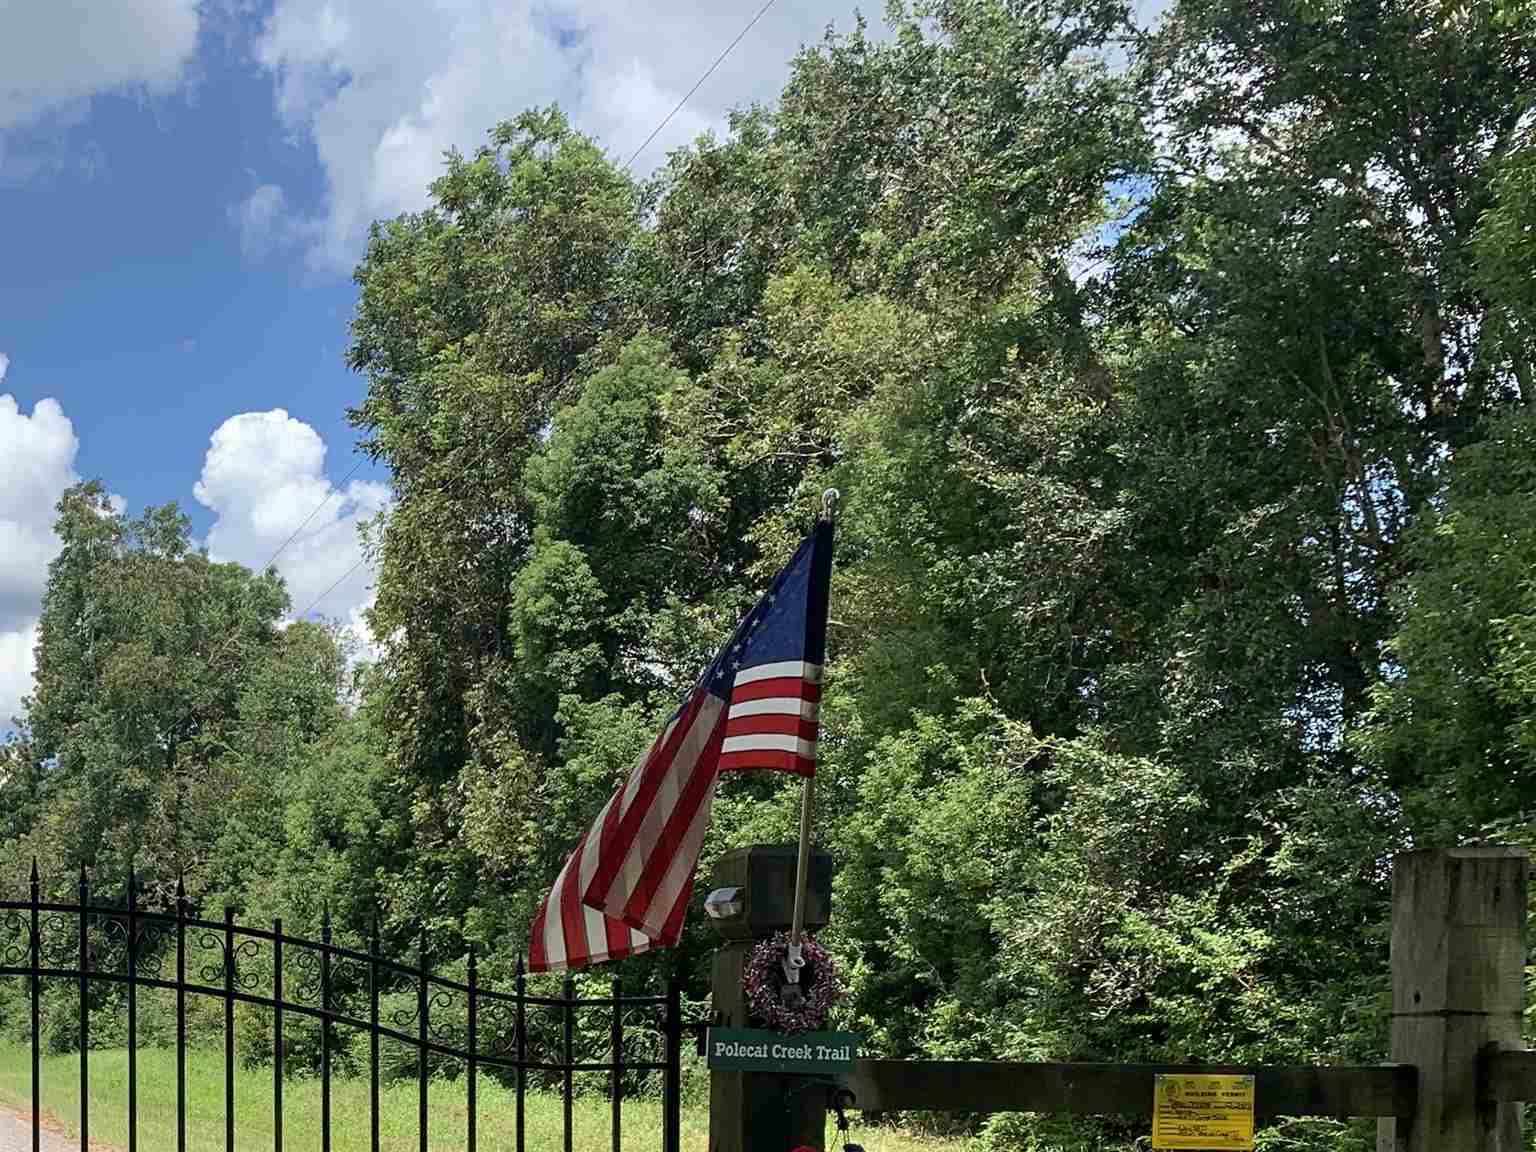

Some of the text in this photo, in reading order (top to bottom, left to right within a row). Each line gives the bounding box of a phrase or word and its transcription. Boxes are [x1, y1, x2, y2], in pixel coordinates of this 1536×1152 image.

[715, 1042, 850, 1061] Polecat Creek Trail
